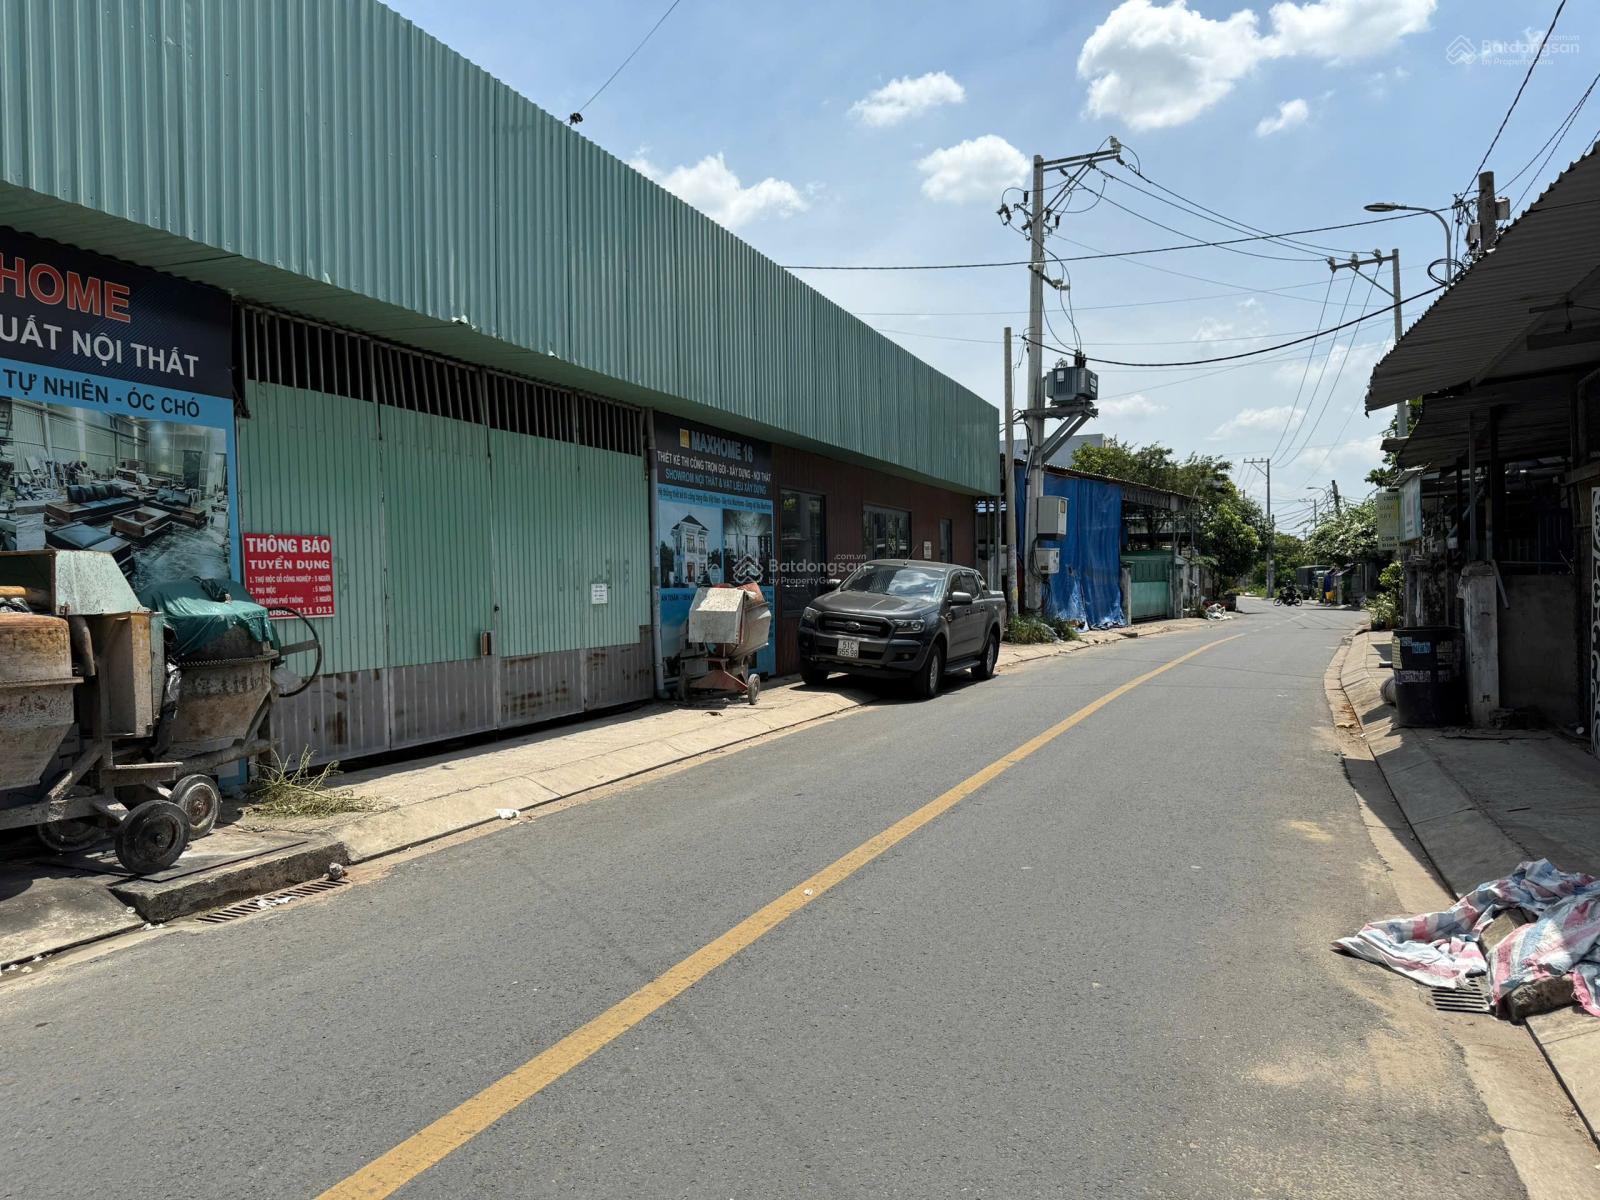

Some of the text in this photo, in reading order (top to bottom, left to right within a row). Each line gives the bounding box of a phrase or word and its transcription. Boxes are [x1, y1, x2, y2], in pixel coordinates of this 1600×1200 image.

[0, 252, 131, 324] HOME
[72, 329, 122, 367] NỘI
[130, 342, 199, 378] THẤT
[3, 367, 37, 396] TỰ
[44, 377, 109, 405] NHIÊN
[127, 386, 155, 411] ÓC
[160, 396, 200, 418] CHÓ
[692, 432, 741, 460] MAXHOME
[246, 534, 330, 553] THÔNG BÁO
[249, 556, 330, 571] TUYỂN DỤNG
[316, 606, 332, 614] 011
